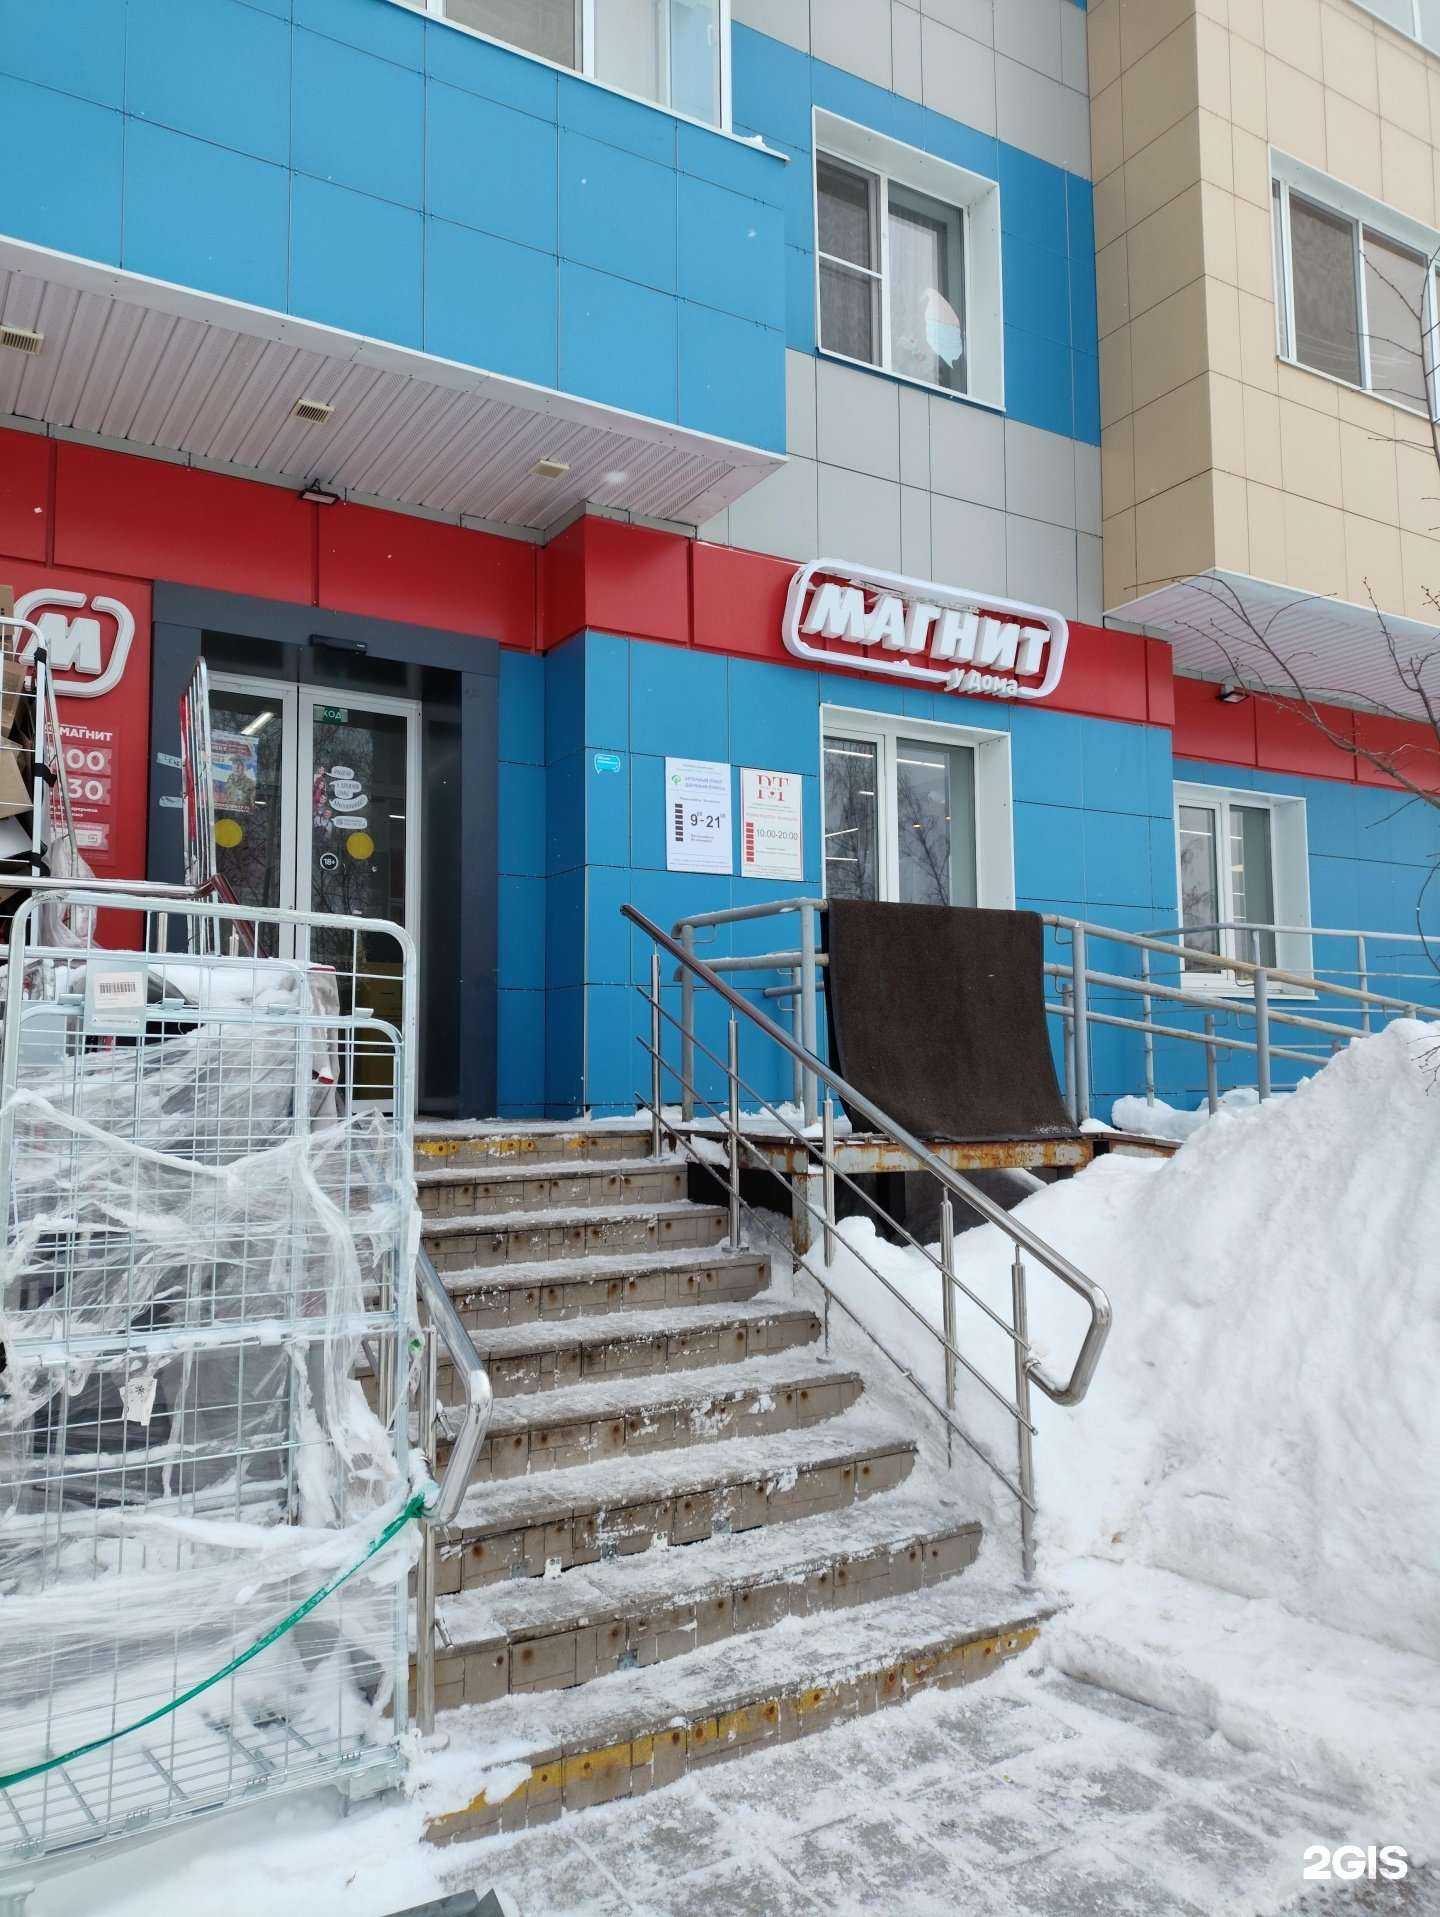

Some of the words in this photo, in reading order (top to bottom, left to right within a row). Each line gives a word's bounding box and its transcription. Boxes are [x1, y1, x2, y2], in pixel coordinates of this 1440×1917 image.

[19, 613, 102, 675] М
[801, 583, 1050, 676] МАГНИТ
[944, 668, 964, 693] у
[962, 671, 1019, 698] дома
[60, 726, 112, 741] МАГНИТ
